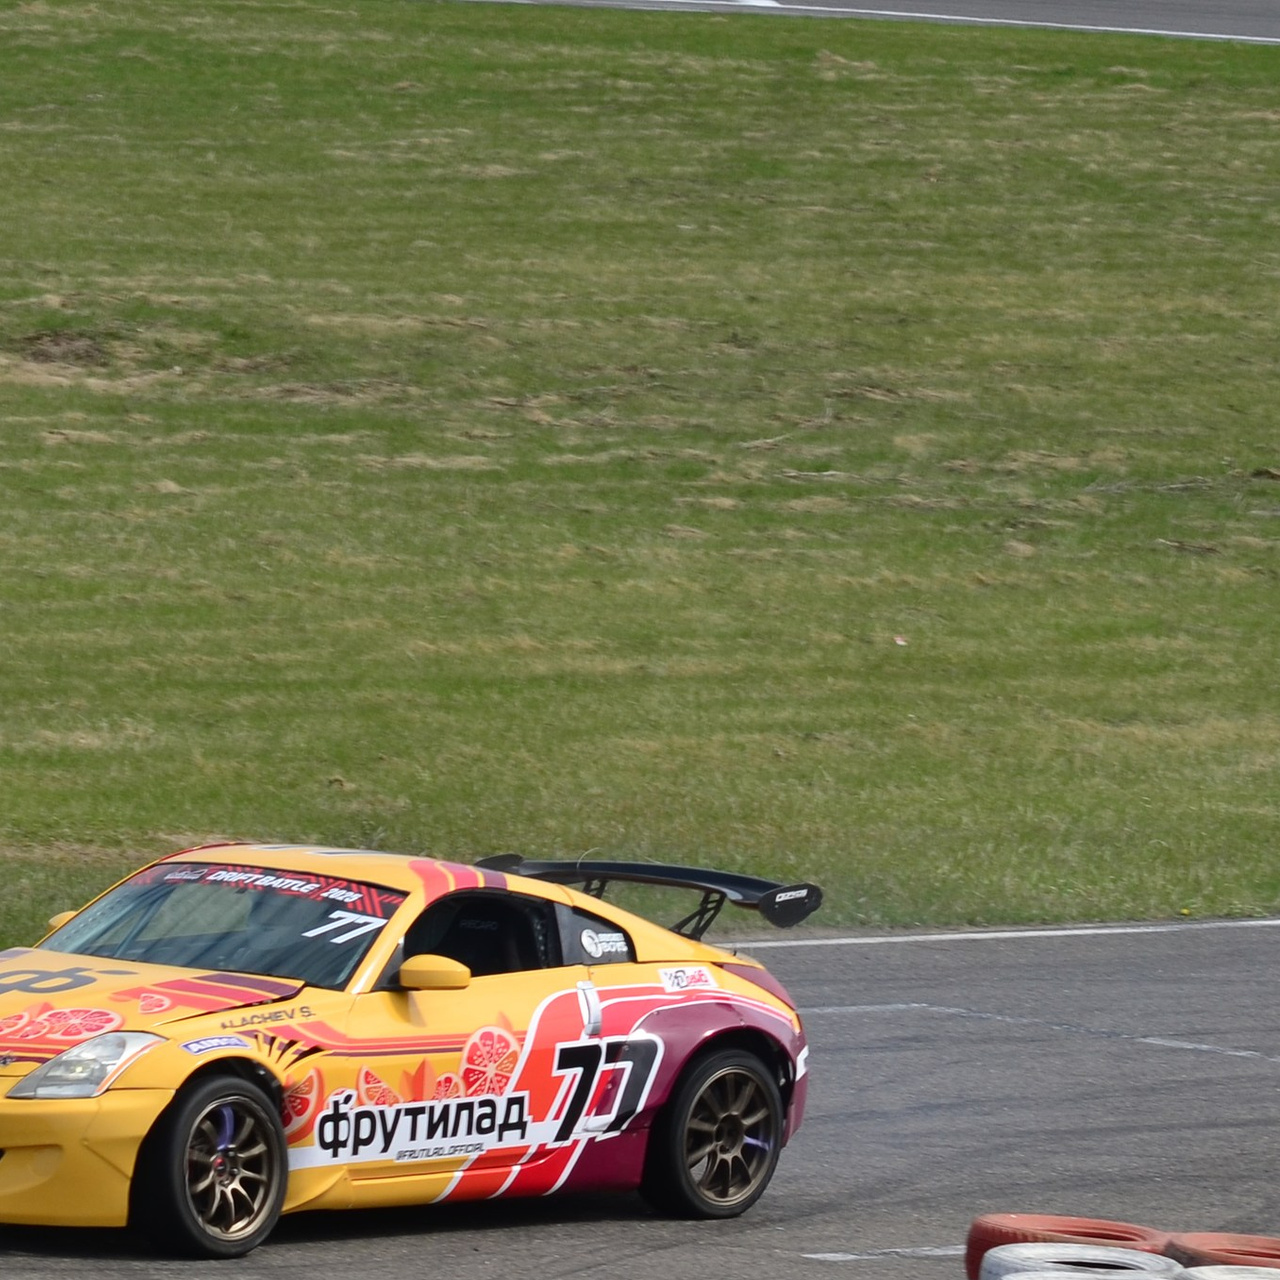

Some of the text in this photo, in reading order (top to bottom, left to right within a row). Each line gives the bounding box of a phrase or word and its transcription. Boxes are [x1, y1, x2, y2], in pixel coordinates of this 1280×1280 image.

[206, 871, 264, 884] DRIFT
[253, 876, 321, 893] BATTLE
[301, 910, 388, 944] 77
[552, 1038, 659, 1142] 77
